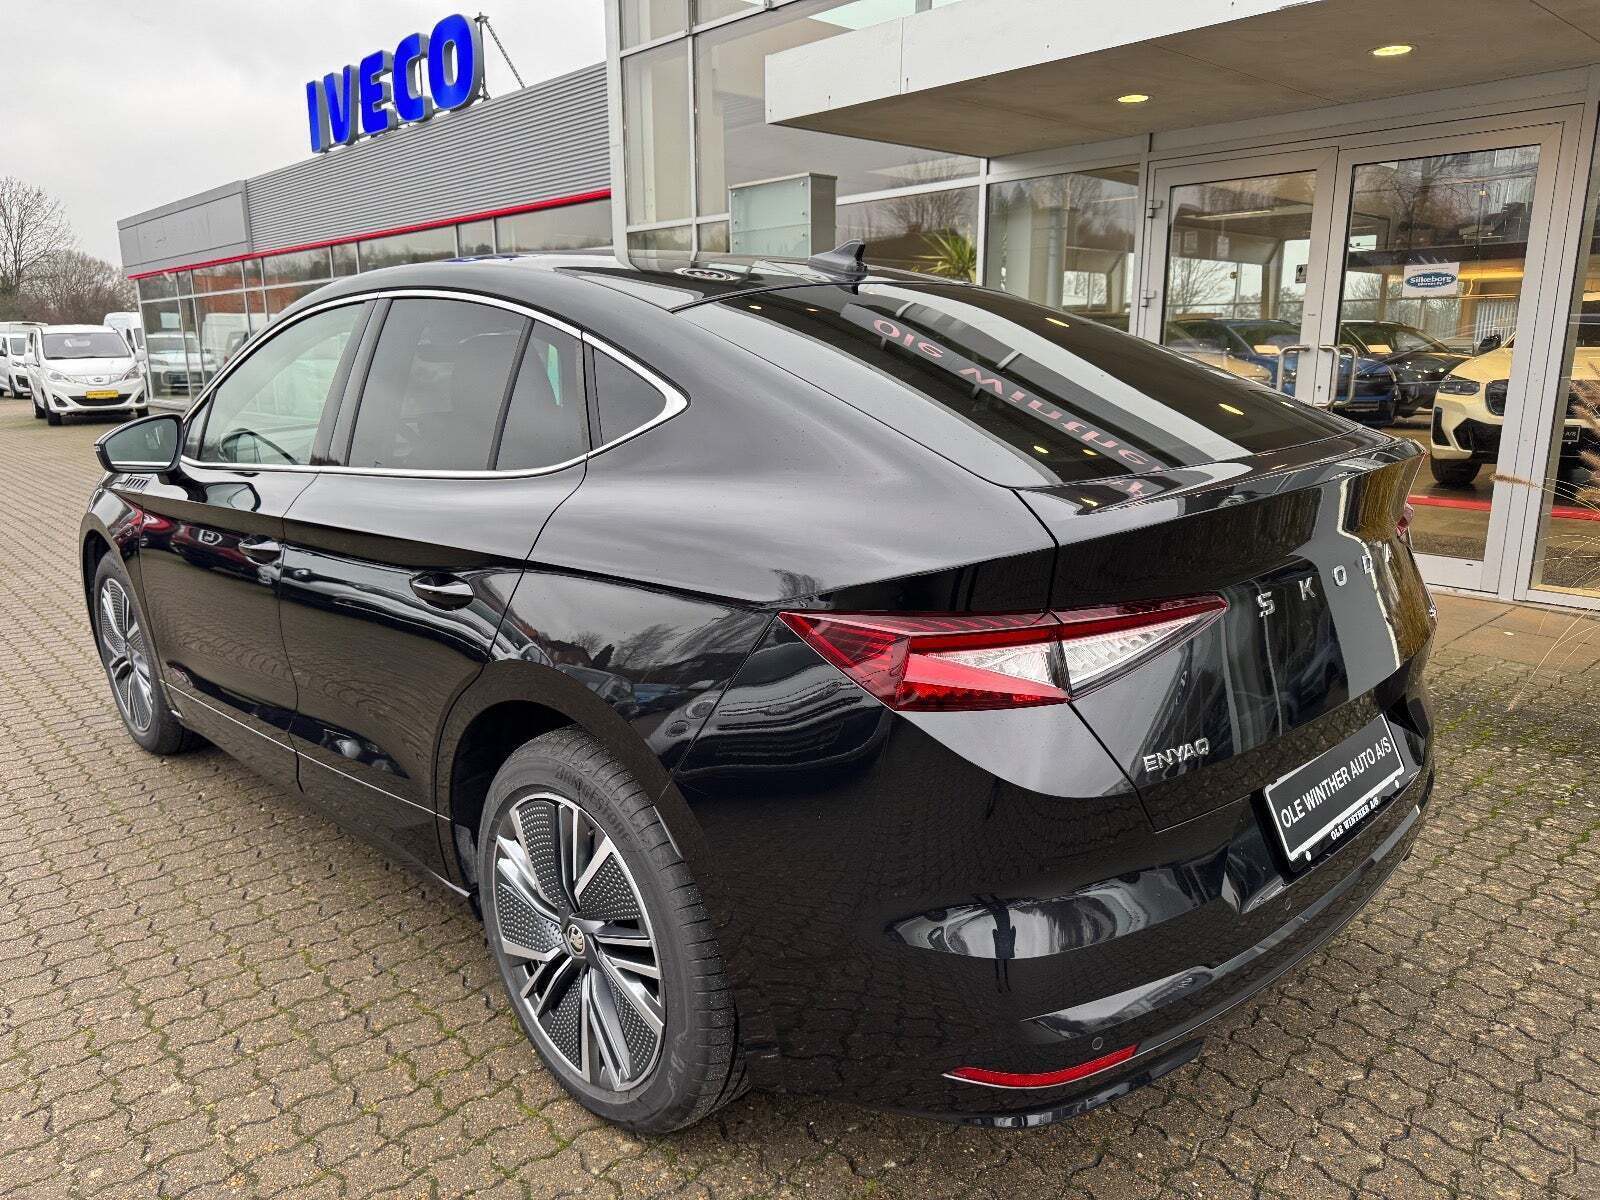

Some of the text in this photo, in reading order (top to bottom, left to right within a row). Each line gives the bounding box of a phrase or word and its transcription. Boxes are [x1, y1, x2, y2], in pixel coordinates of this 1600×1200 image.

[306, 13, 482, 153] IVECO
[1142, 737, 1210, 772] ENYAQ
[1280, 736, 1392, 828] OLE WINTHER AUTO A/S
[1330, 796, 1379, 841] OLE WINTHER A/S
